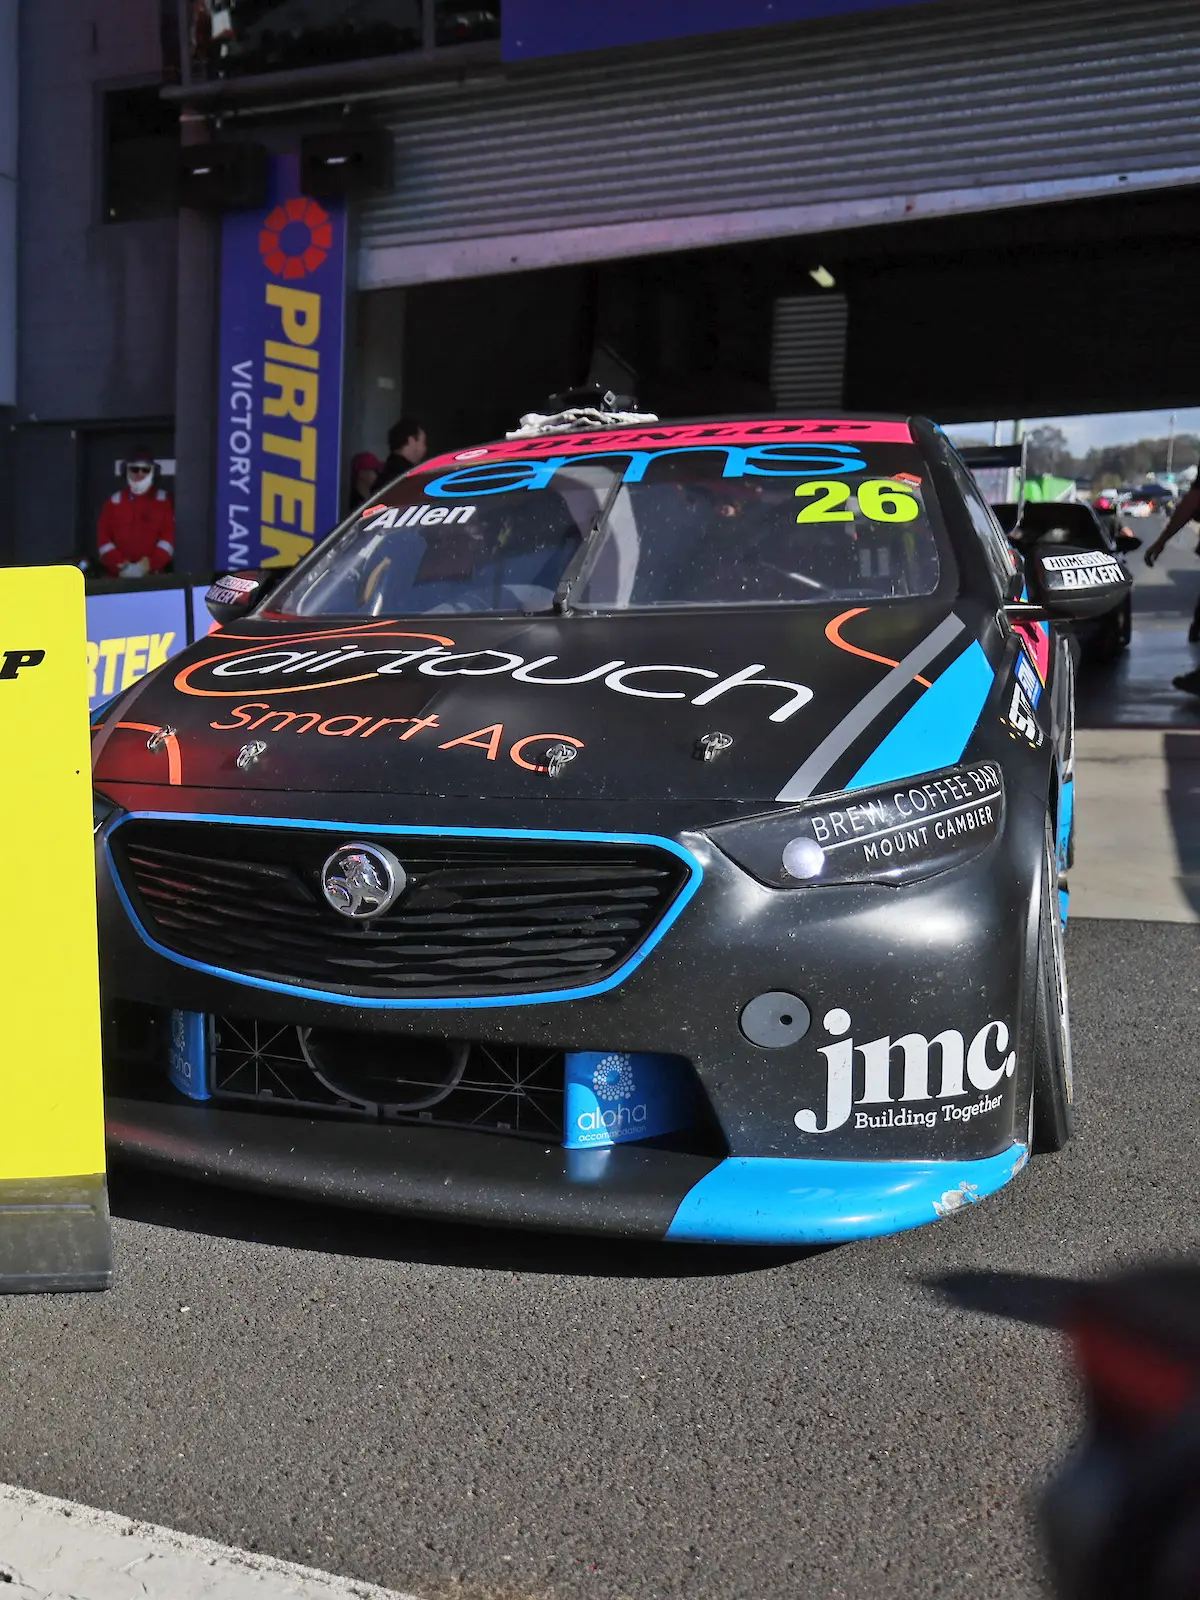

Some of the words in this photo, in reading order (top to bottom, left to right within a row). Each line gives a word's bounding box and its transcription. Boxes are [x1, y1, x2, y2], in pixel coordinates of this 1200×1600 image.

[228, 359, 254, 494] VICTORY
[514, 424, 872, 451] DUNLOP
[362, 503, 477, 532] Allen
[794, 479, 919, 524] 26
[227, 503, 250, 571] LAN
[1061, 563, 1126, 587] BAKERY
[211, 644, 816, 724] airtouch
[209, 702, 440, 742] Smart
[437, 722, 586, 773] AC
[810, 799, 887, 842] BREW
[893, 775, 973, 816] COFFEE
[968, 765, 1000, 793] BAR
[863, 826, 930, 862] MOUNT
[933, 805, 995, 841] GAMBIER
[577, 1103, 647, 1131] aloha
[854, 1109, 938, 1129] Building
[940, 1094, 1004, 1122] Together
